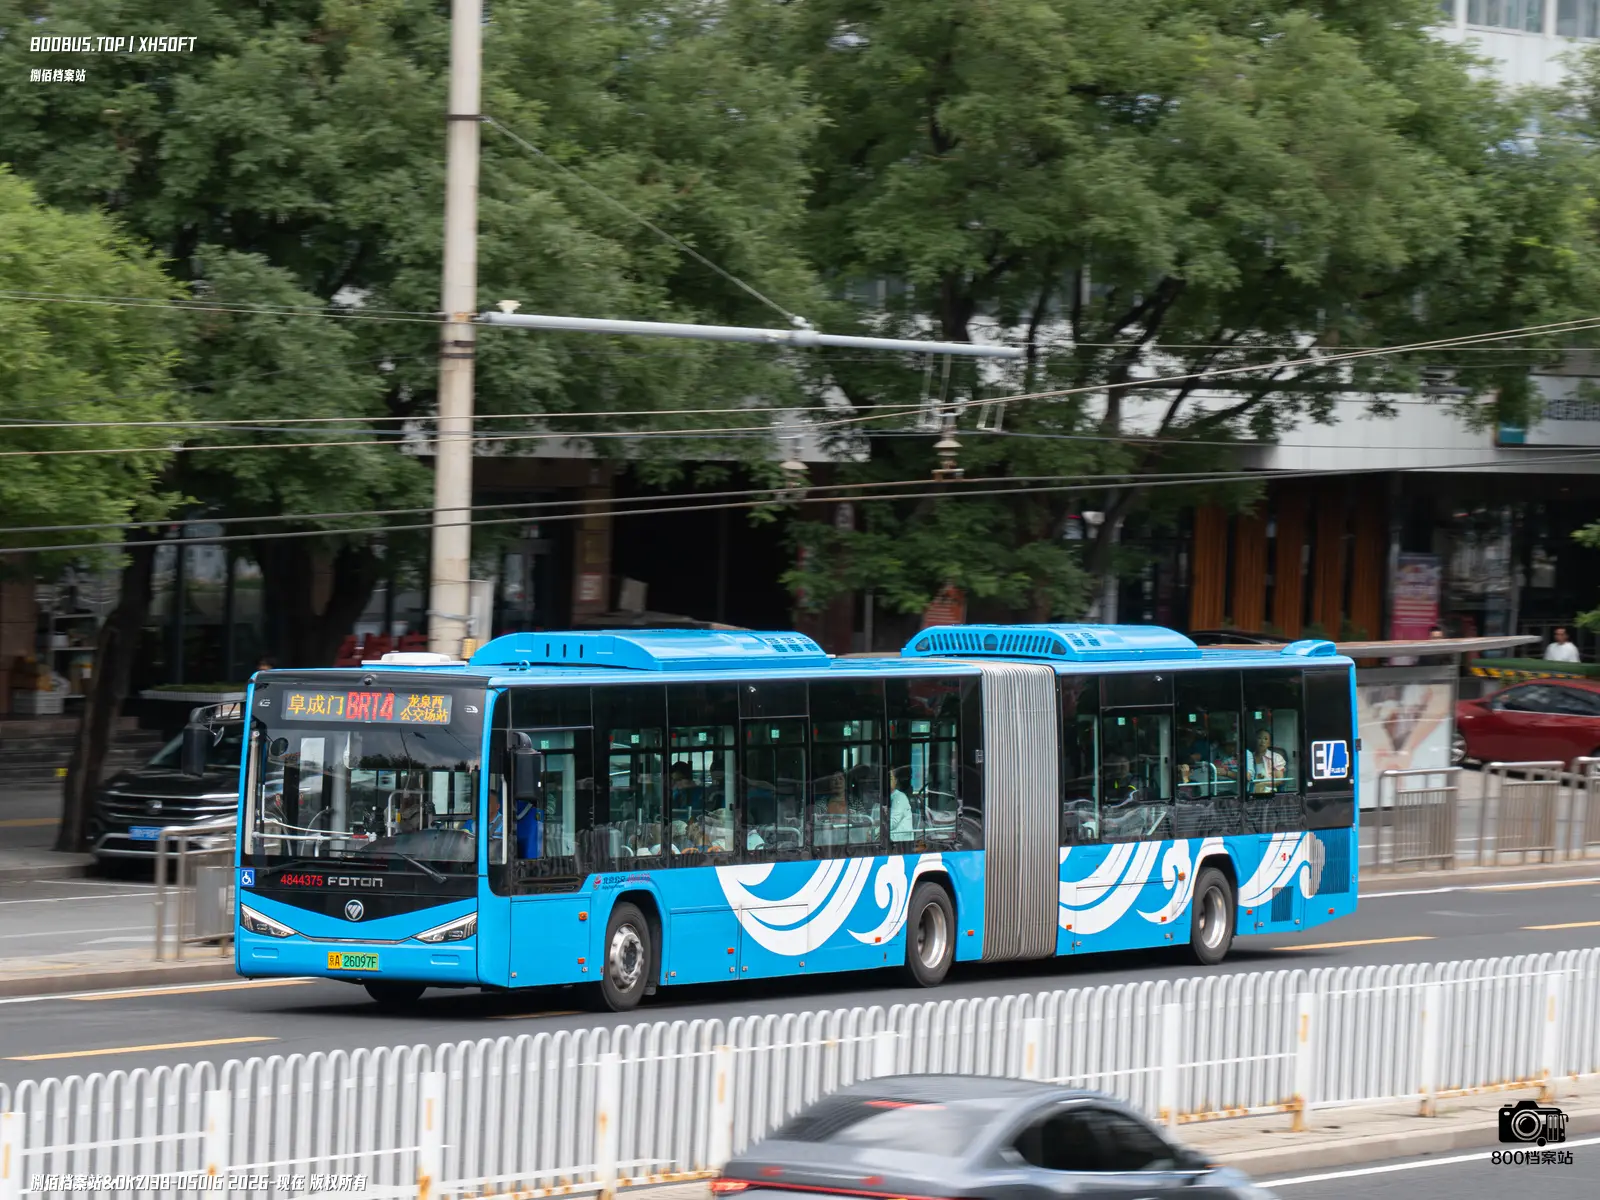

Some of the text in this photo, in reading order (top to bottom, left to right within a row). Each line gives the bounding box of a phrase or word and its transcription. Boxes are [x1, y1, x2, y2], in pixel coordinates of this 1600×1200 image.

[288, 691, 395, 721] 阜成门 BRT4
[408, 694, 445, 708] 龙泉西
[400, 709, 449, 722] 公交场站
[280, 874, 383, 887] 4844375 FOTON
[343, 955, 377, 968] 26097F
